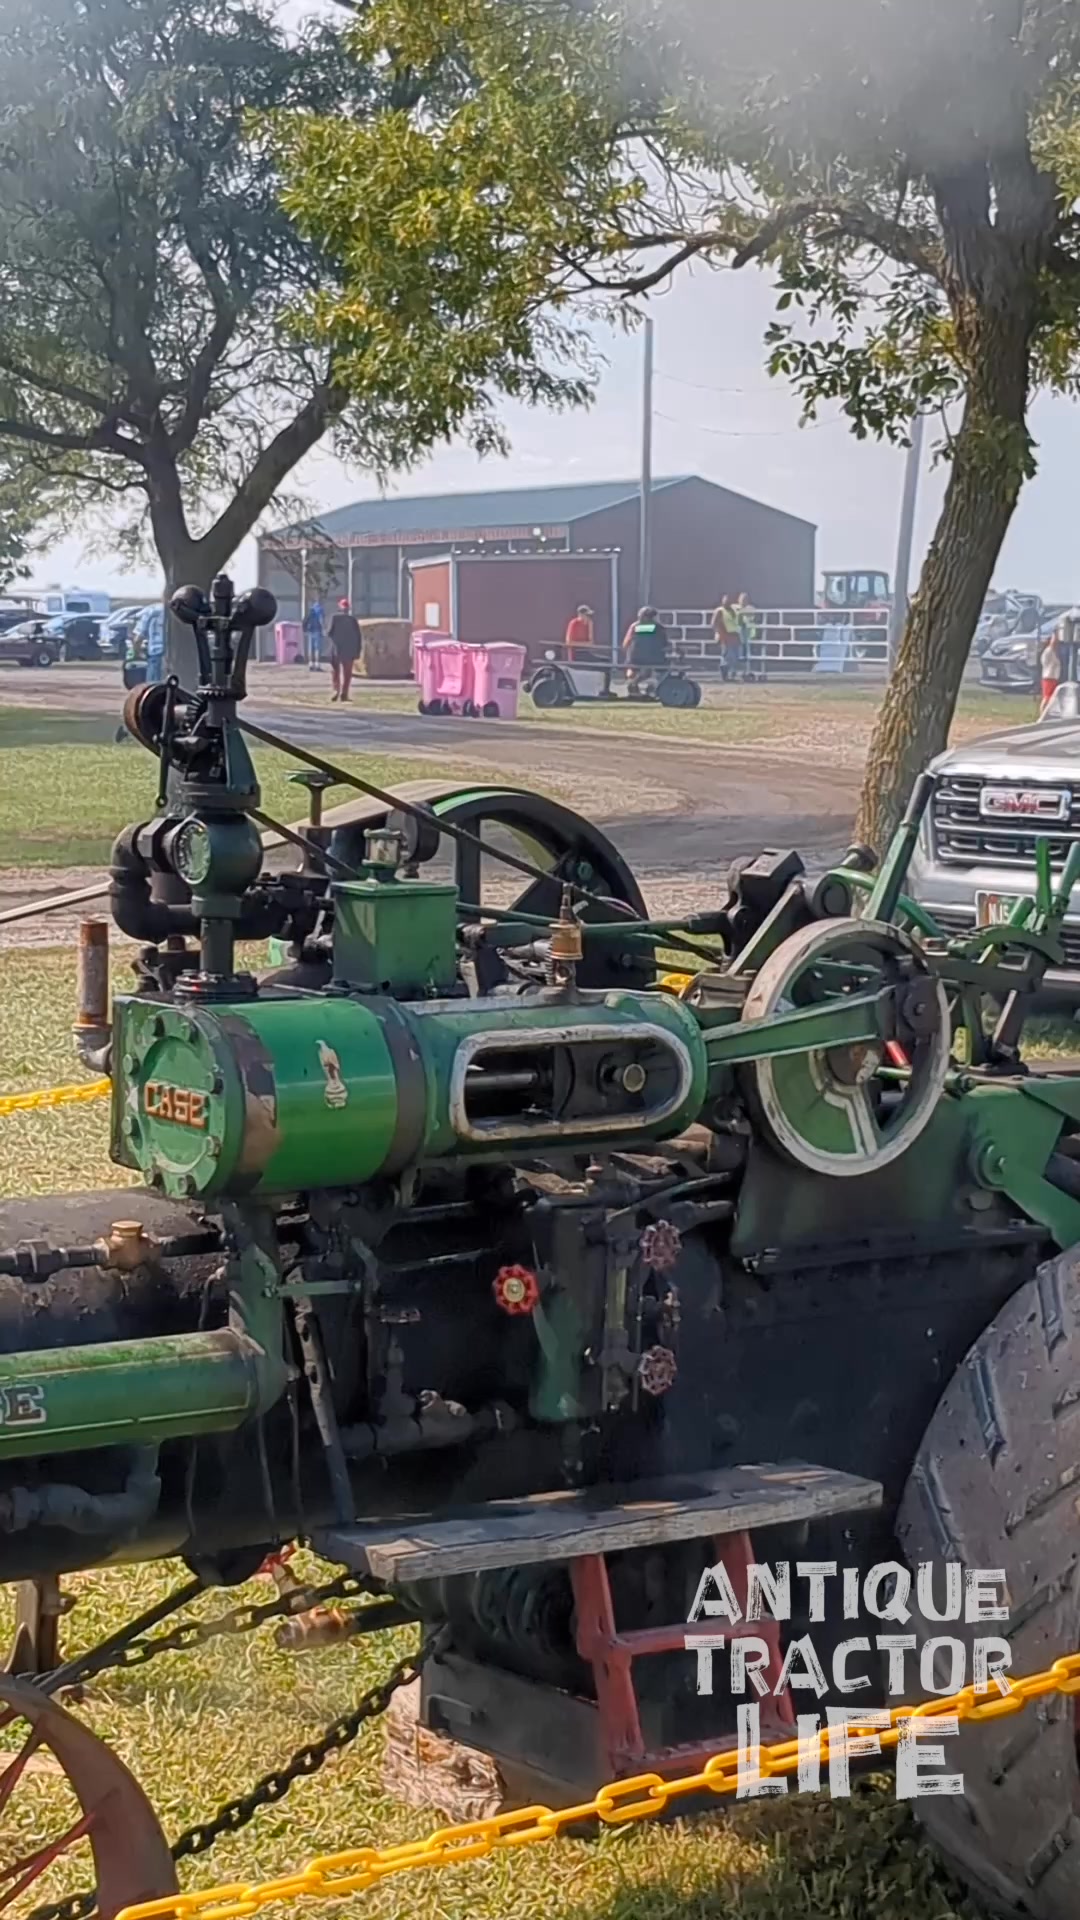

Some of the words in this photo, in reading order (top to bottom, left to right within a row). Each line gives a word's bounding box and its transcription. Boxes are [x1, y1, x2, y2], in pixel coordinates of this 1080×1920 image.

[985, 792, 1059, 814] GMC
[144, 1081, 208, 1129] CASE
[0, 1384, 47, 1425] E
